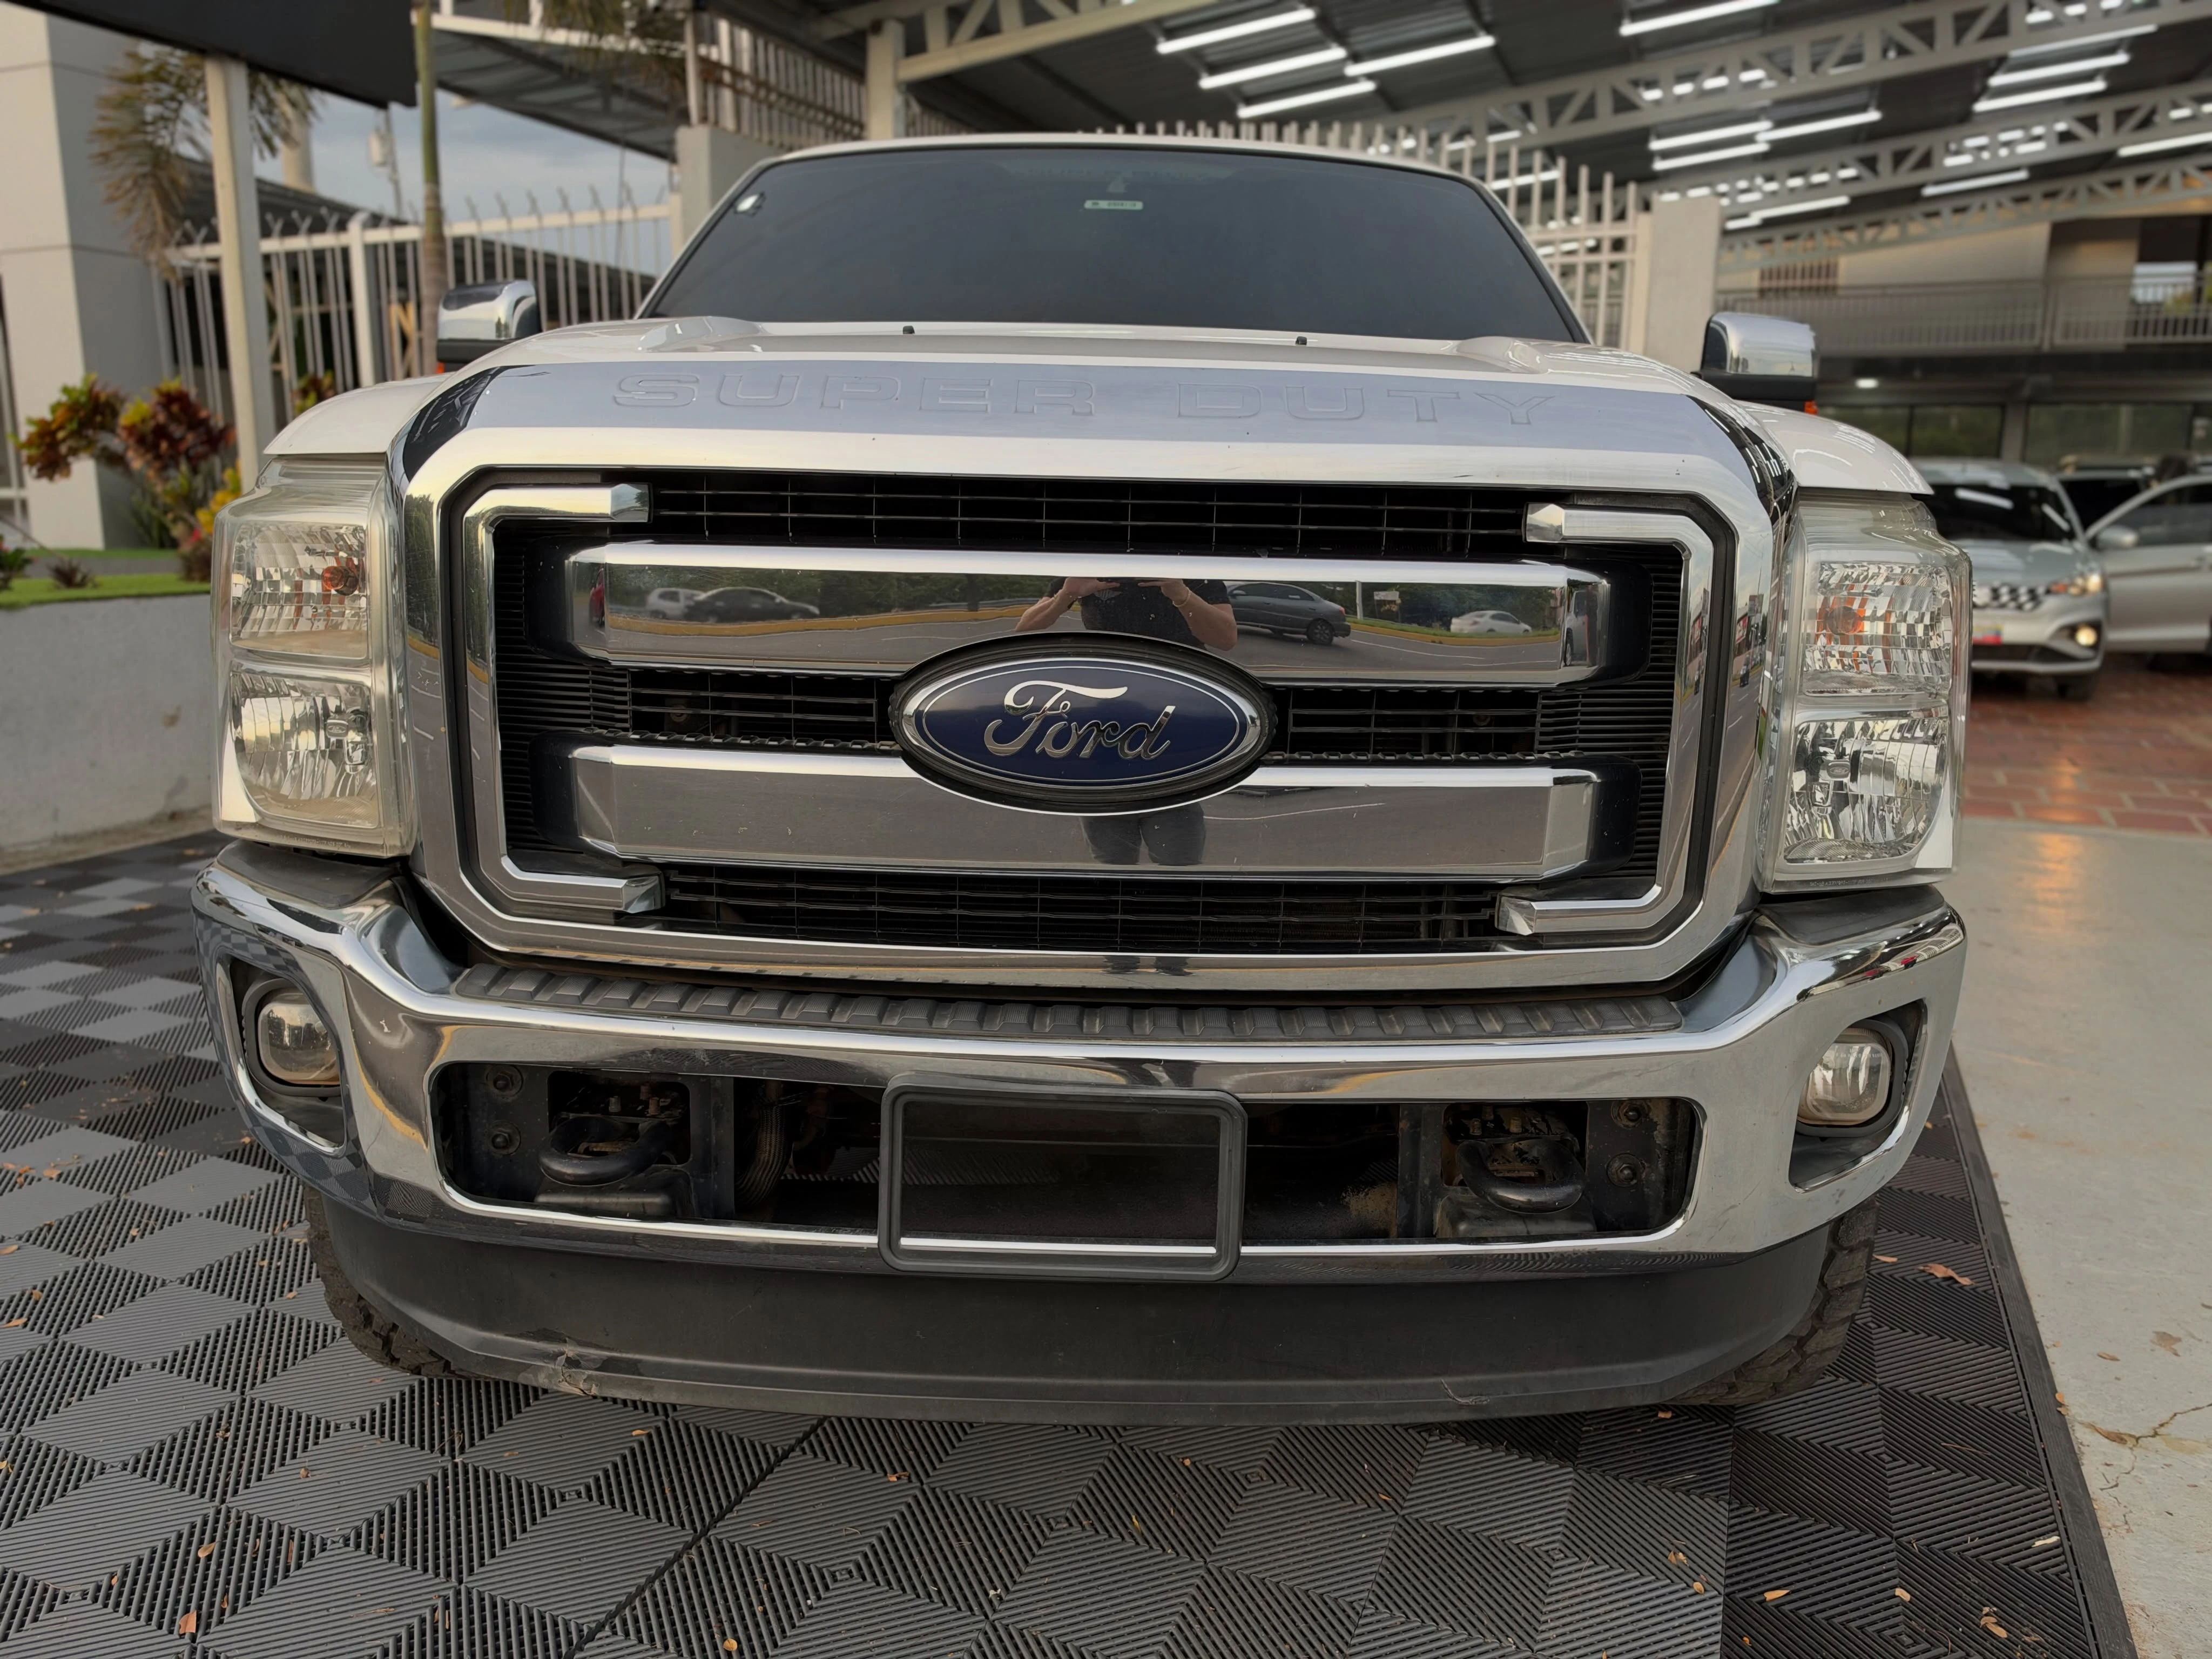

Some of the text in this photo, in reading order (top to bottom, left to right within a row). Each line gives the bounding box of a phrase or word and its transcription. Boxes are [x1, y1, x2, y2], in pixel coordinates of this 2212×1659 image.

[613, 374, 1555, 424] SUPER DUTY
[984, 680, 1176, 760] Ford
